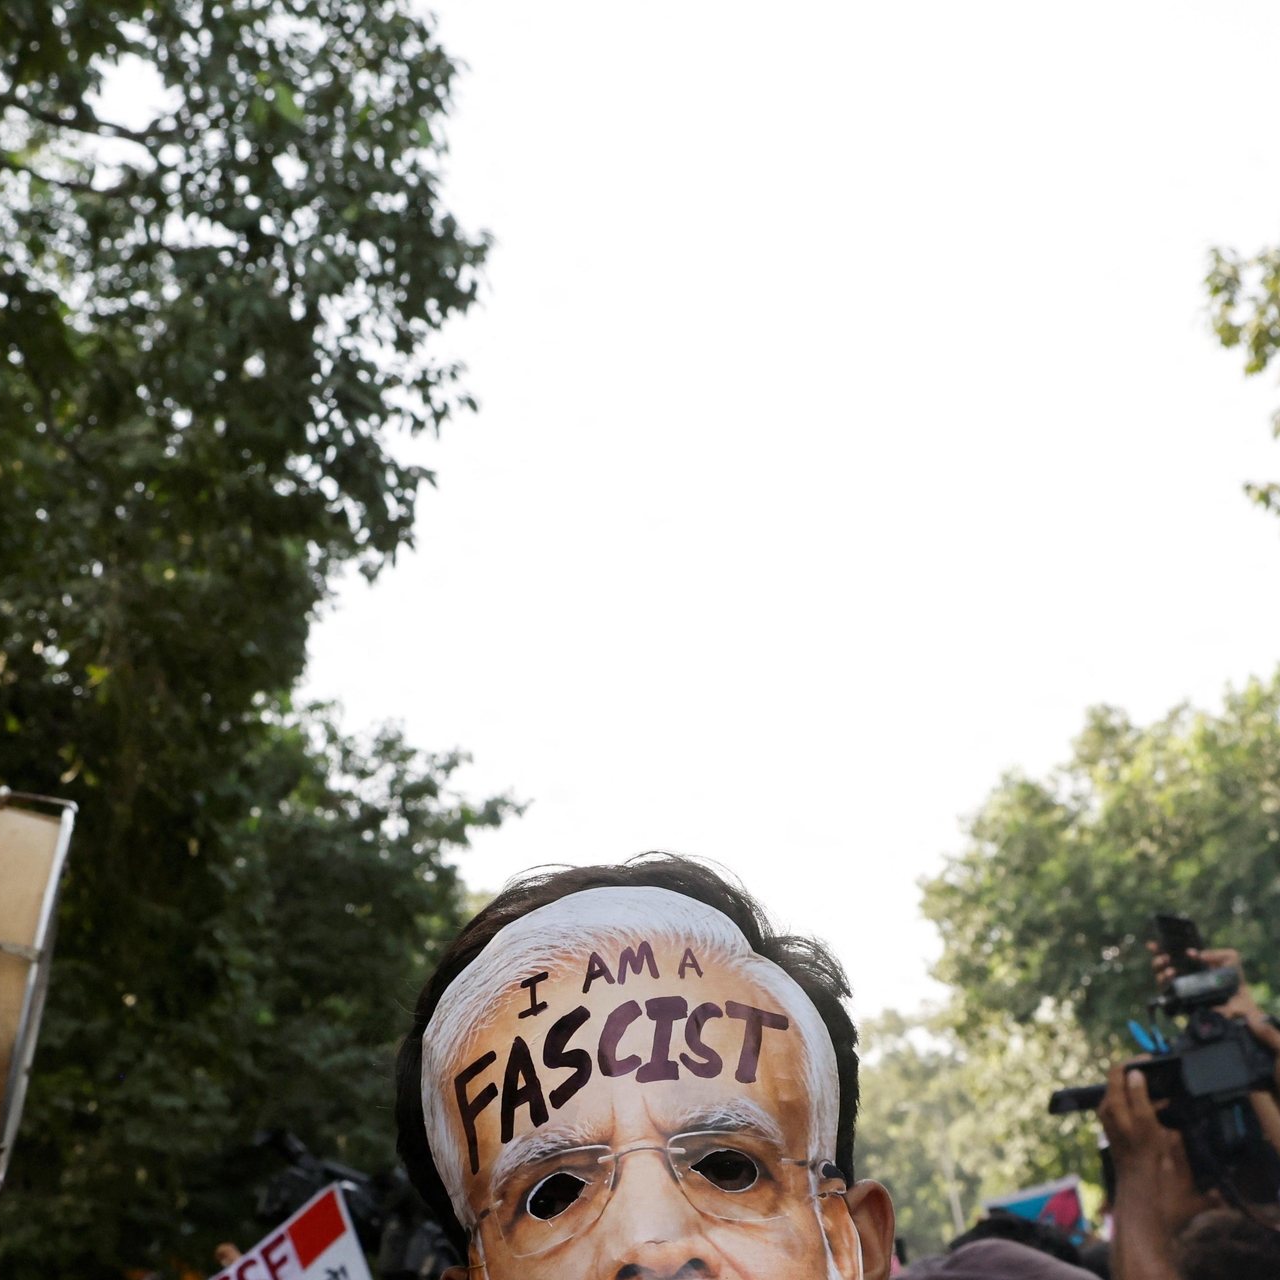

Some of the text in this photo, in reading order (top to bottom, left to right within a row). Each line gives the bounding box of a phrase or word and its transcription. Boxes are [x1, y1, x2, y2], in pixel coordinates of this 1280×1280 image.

[519, 941, 703, 1019] I AM A
[454, 996, 789, 1175] FASCIST
